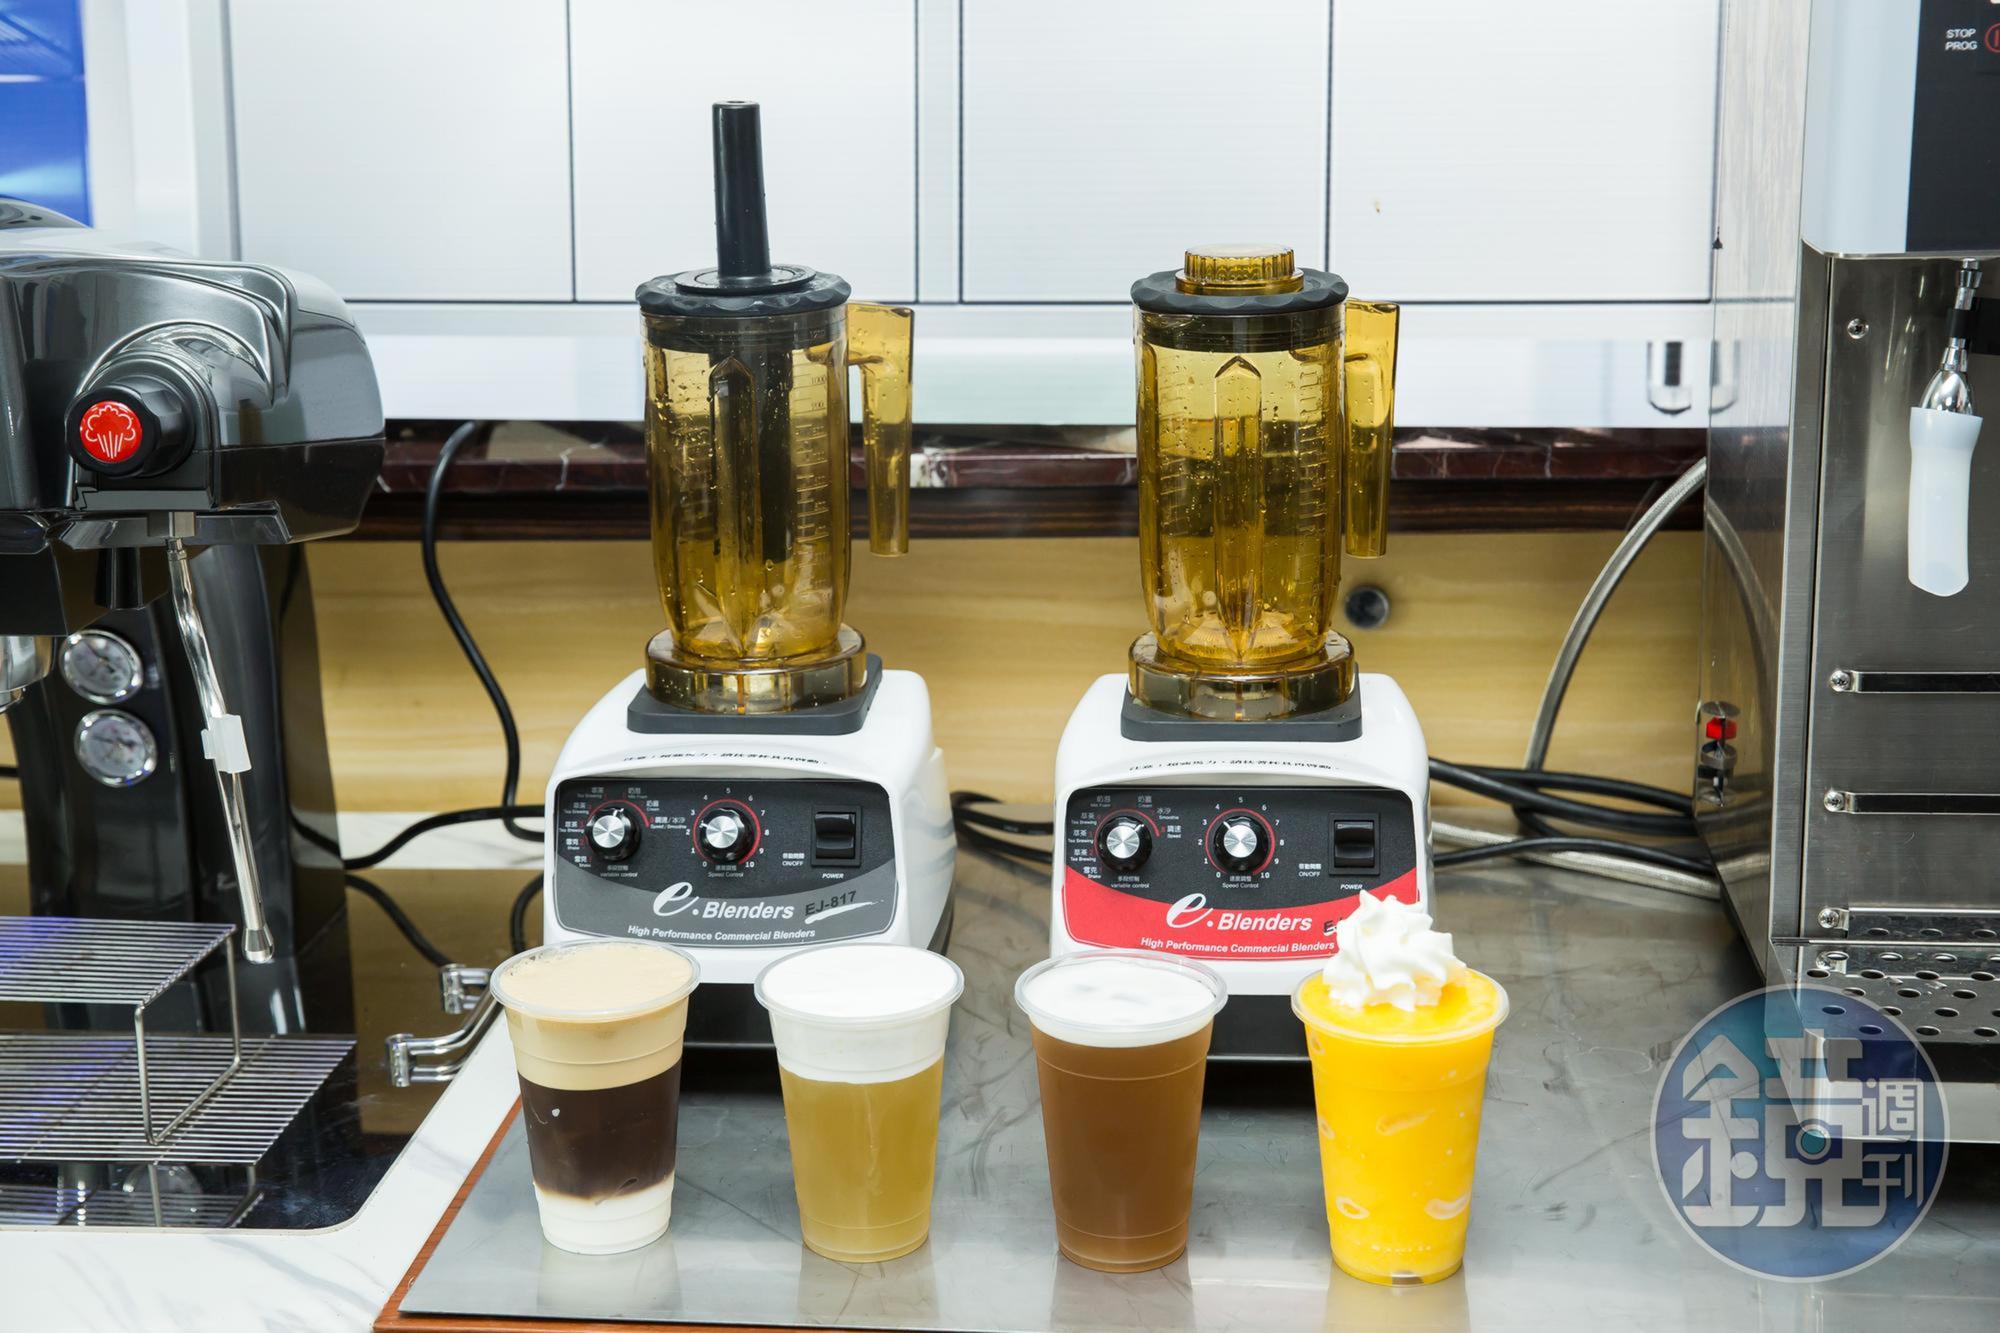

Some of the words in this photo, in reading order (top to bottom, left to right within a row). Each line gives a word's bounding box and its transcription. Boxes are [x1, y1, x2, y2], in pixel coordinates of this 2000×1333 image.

[1946, 28, 1977, 39] STOP
[1945, 41, 1978, 51] PROG
[702, 901, 795, 919] Blenders
[804, 890, 858, 917] EJ-817
[1217, 913, 1312, 930] Blenders
[627, 924, 651, 937] High
[652, 928, 712, 940] Performance
[715, 932, 771, 941] Commercial
[773, 929, 816, 939] Blenders
[1141, 937, 1163, 949] High
[1166, 941, 1227, 953] Performance
[1230, 944, 1289, 953] Commercial
[1291, 940, 1335, 952] Blenders
